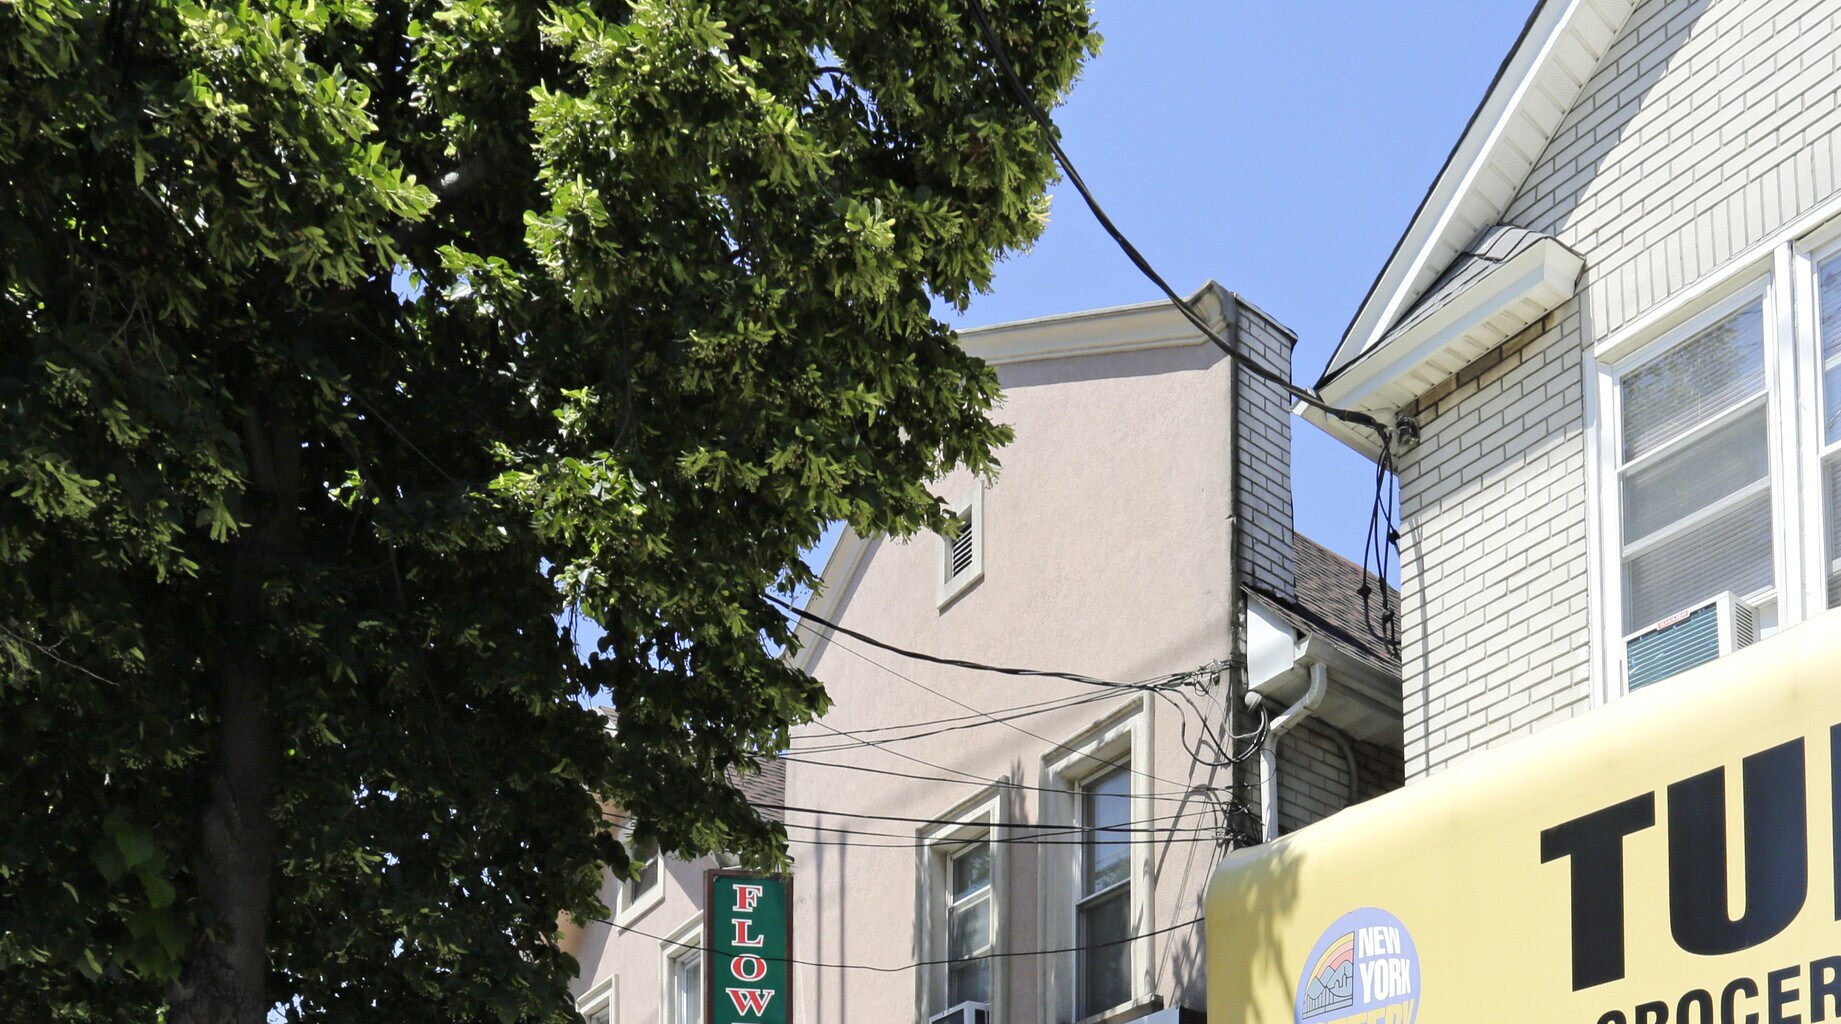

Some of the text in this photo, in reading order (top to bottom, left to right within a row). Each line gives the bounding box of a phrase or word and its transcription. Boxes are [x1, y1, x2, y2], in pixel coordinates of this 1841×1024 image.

[1540, 722, 1841, 992] TU
[1358, 926, 1401, 958] NEW
[1359, 958, 1411, 1004] YORK
